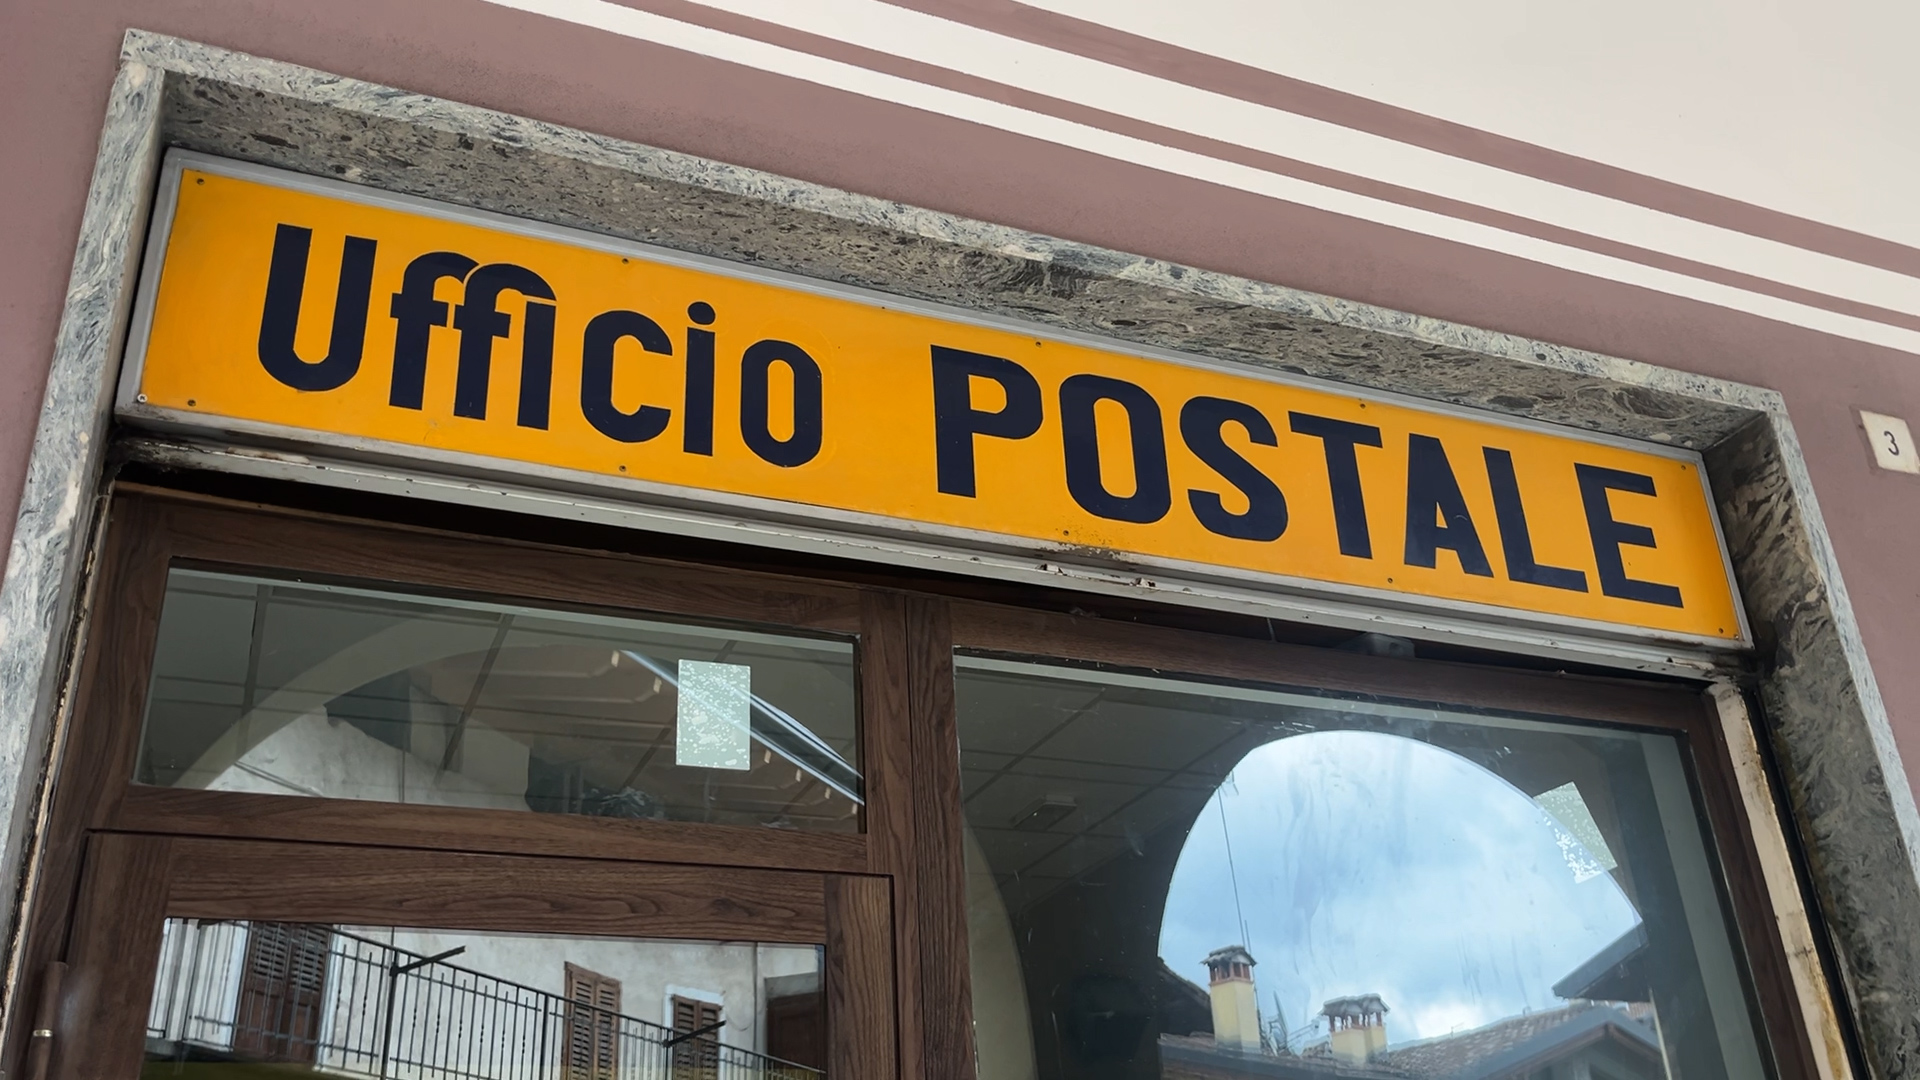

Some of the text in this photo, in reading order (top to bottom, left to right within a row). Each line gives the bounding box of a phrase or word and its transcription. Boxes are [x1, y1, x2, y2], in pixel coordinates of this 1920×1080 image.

[257, 222, 1684, 609] Ufficio POSTALE
[1884, 430, 1900, 456] 3
